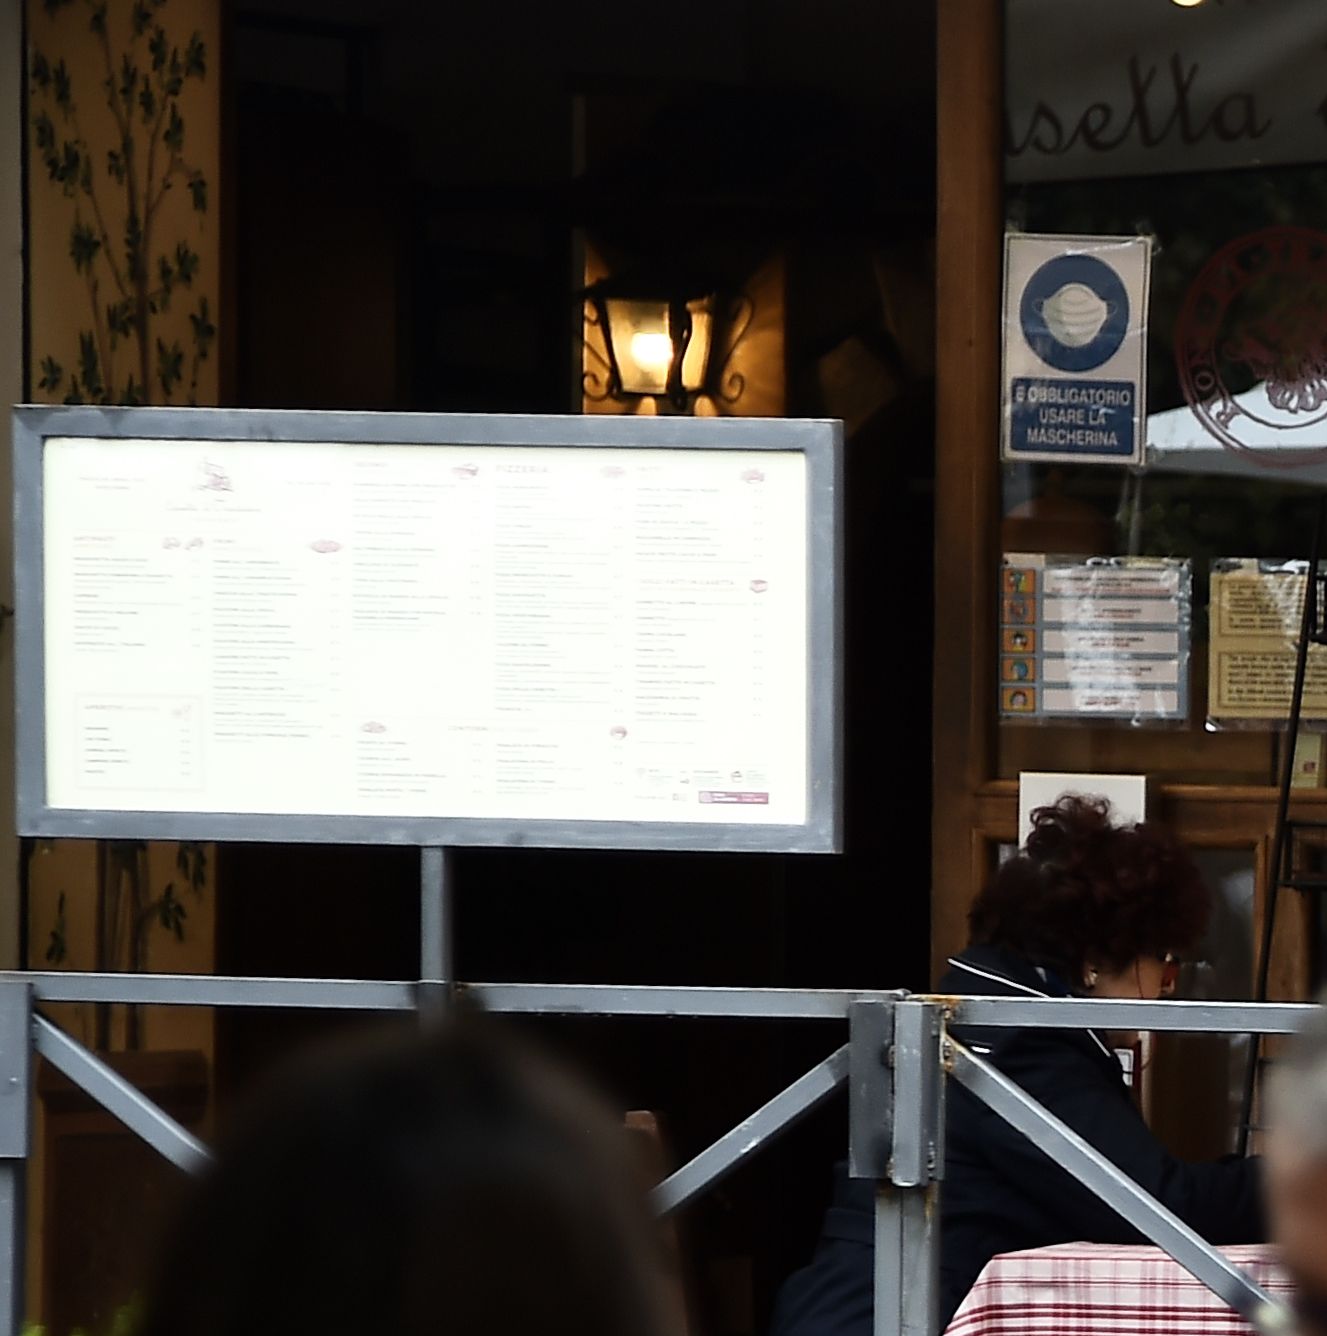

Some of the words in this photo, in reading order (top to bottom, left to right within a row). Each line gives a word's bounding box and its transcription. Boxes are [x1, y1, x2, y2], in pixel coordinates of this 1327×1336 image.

[1005, 52, 1272, 157] setta
[1027, 386, 1132, 406] OBBLIGATORIO
[1039, 408, 1085, 424] USARE
[1088, 409, 1107, 425] LA
[1027, 428, 1118, 446] MASCHERINA
